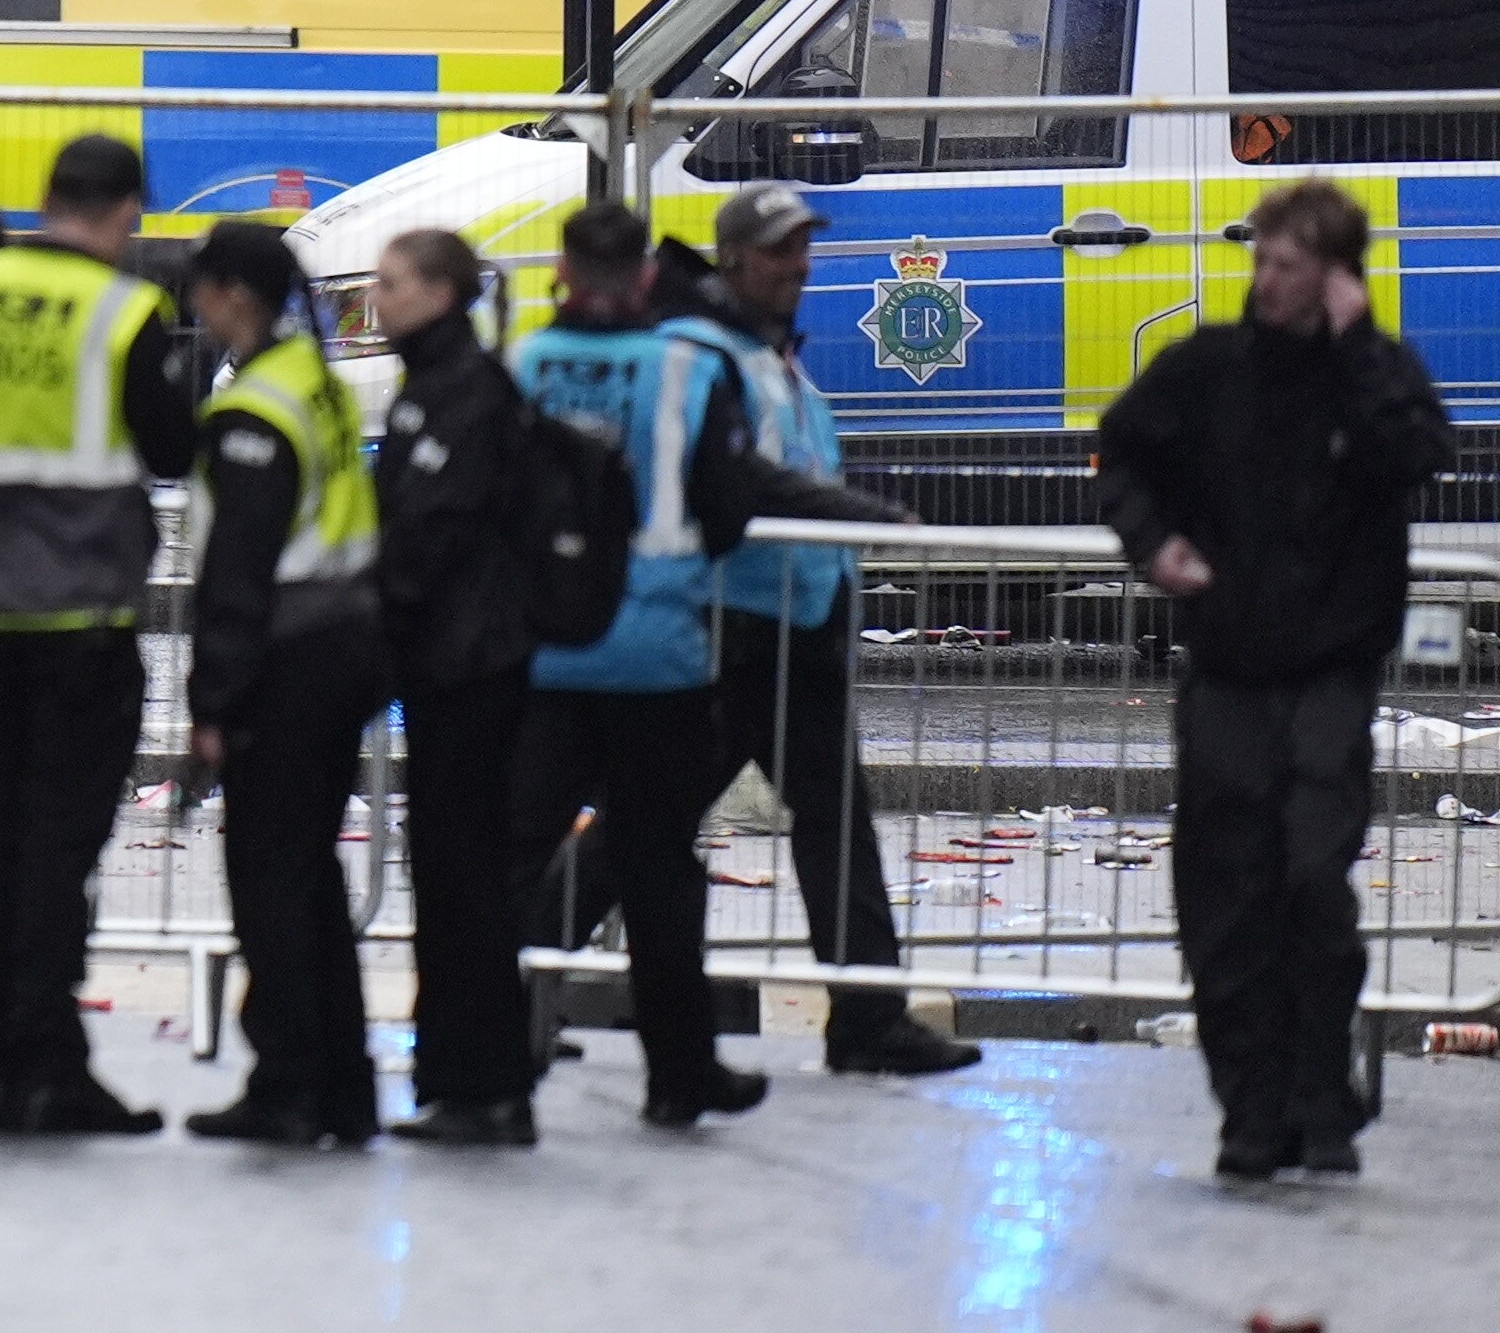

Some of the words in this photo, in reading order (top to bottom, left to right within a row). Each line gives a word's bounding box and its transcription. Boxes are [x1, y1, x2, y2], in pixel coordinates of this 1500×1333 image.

[884, 283, 957, 318] MERSEYSIDE
[900, 306, 944, 340] ER
[895, 343, 947, 360] POLICE
